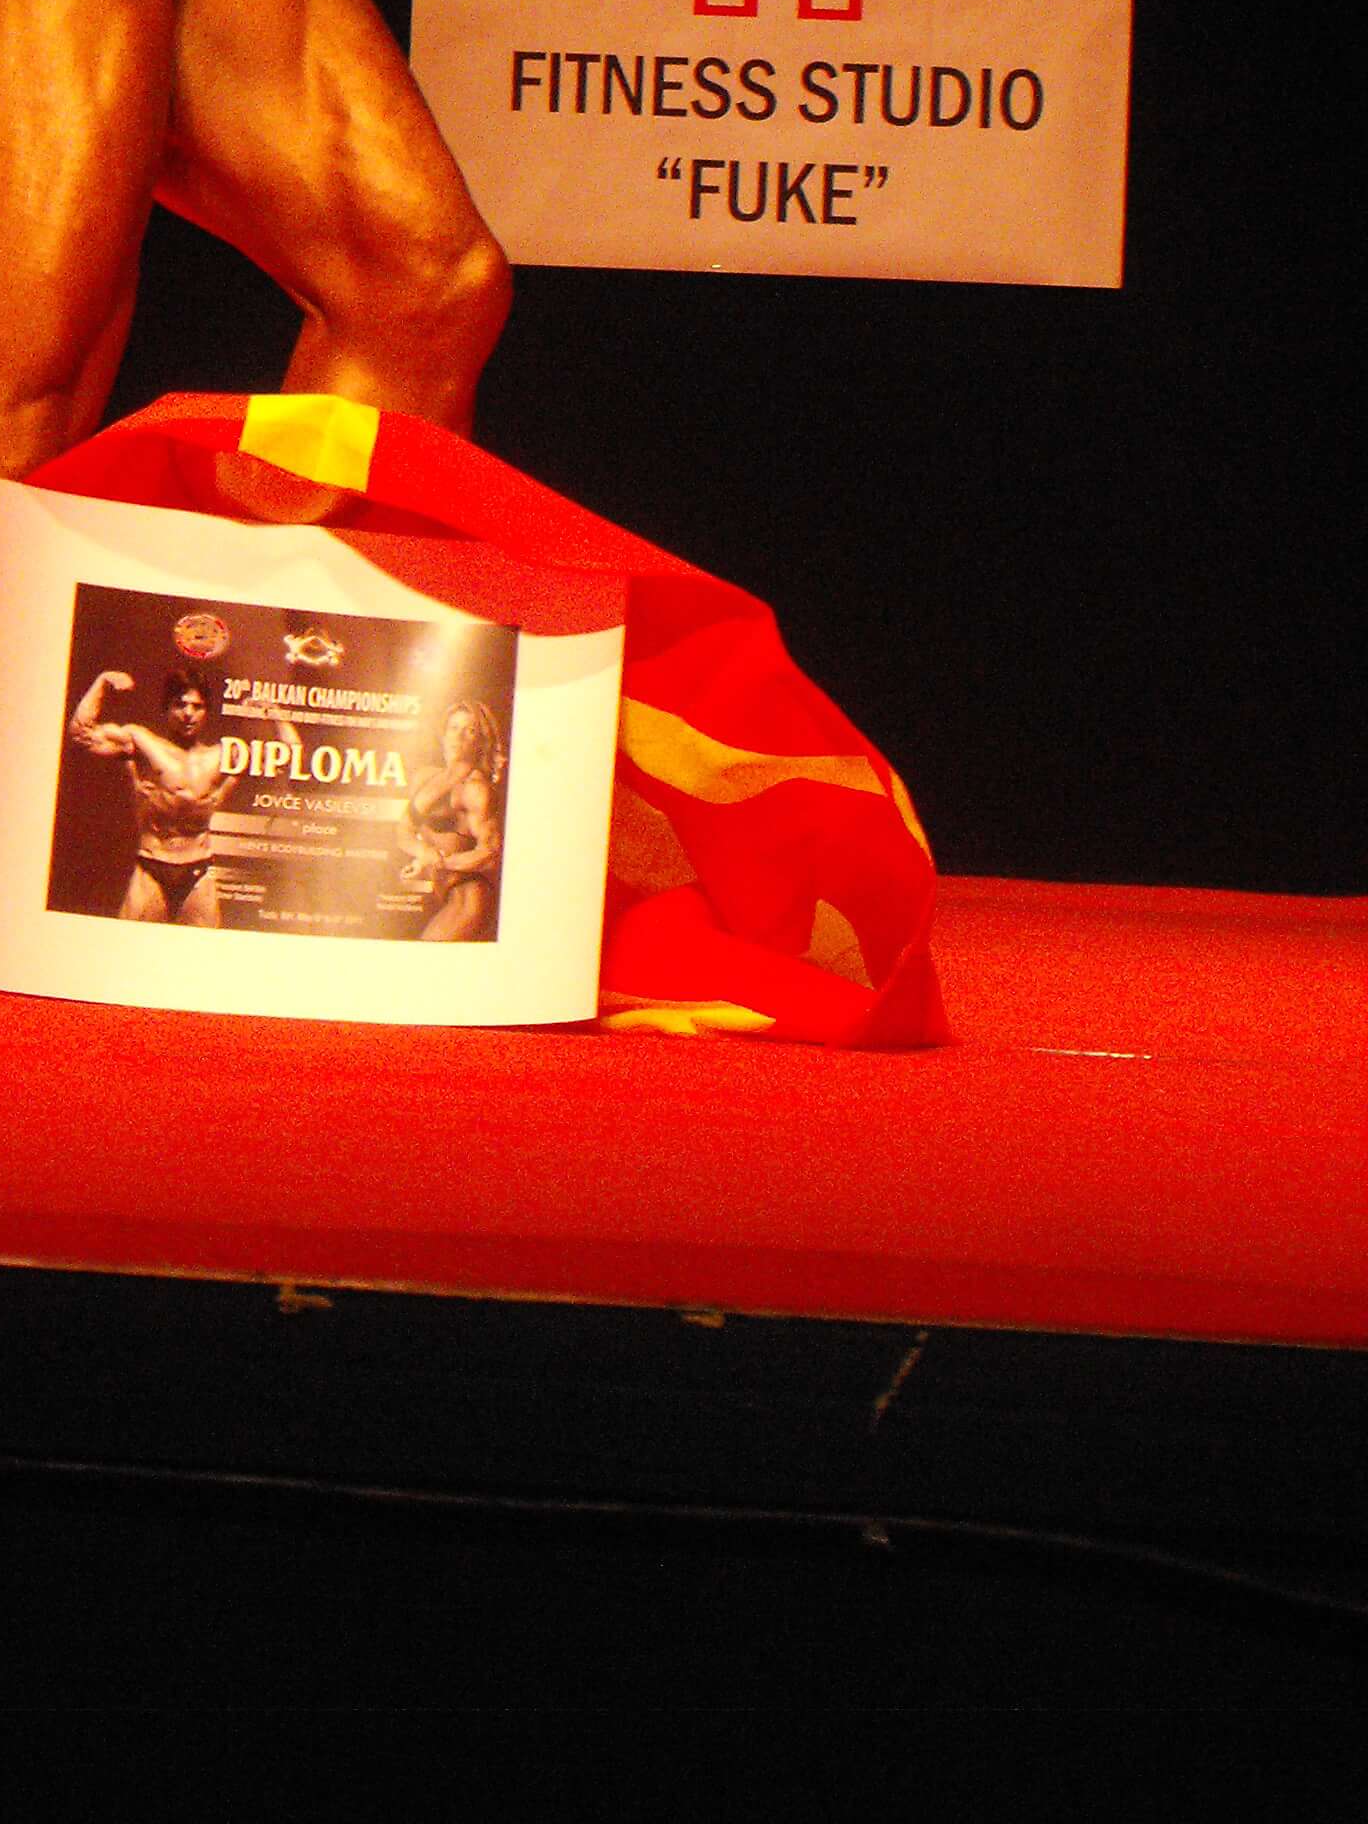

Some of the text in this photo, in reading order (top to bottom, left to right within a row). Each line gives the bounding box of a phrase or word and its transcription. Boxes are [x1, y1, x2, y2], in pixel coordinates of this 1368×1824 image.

[510, 49, 1046, 132] FITNESS STUDIO
[252, 680, 306, 706] BALKAN
[308, 686, 422, 715] CHAMPIONSHIPS
[219, 736, 409, 787] DIPLOMA
